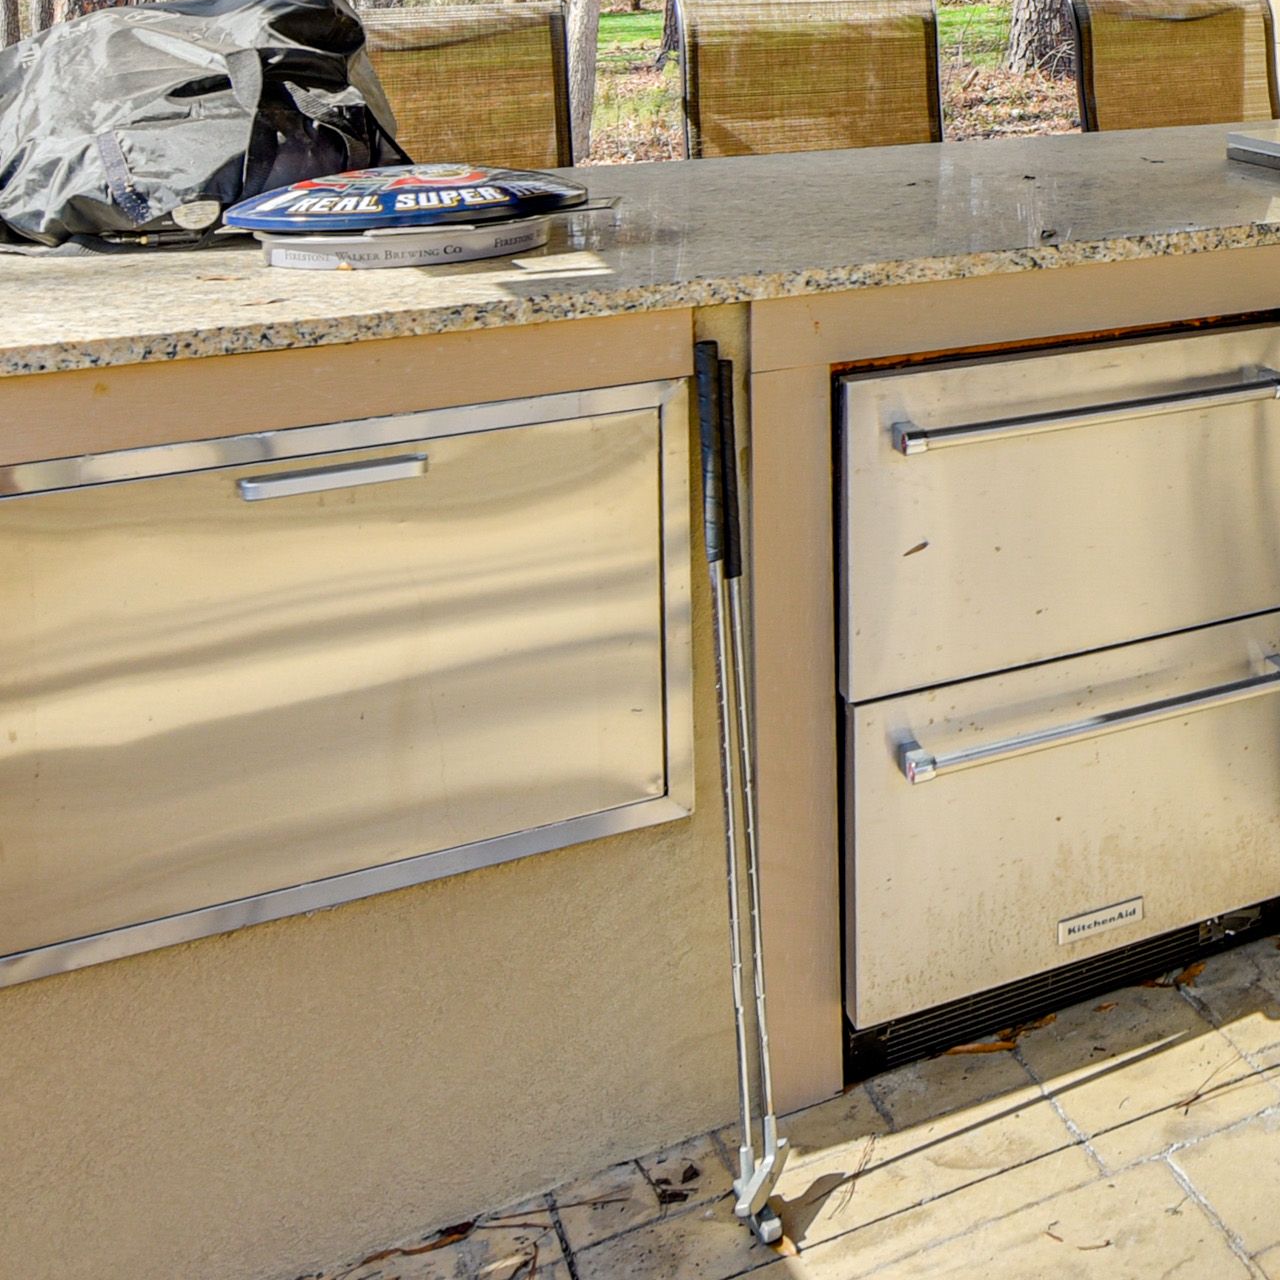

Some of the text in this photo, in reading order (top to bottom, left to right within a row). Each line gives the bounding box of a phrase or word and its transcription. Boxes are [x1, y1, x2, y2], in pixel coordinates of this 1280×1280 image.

[286, 194, 380, 214] REAL
[394, 186, 508, 211] SUPER
[335, 250, 380, 261] WALKER
[384, 248, 440, 261] BREWING
[1067, 908, 1137, 936] KitchenAid
